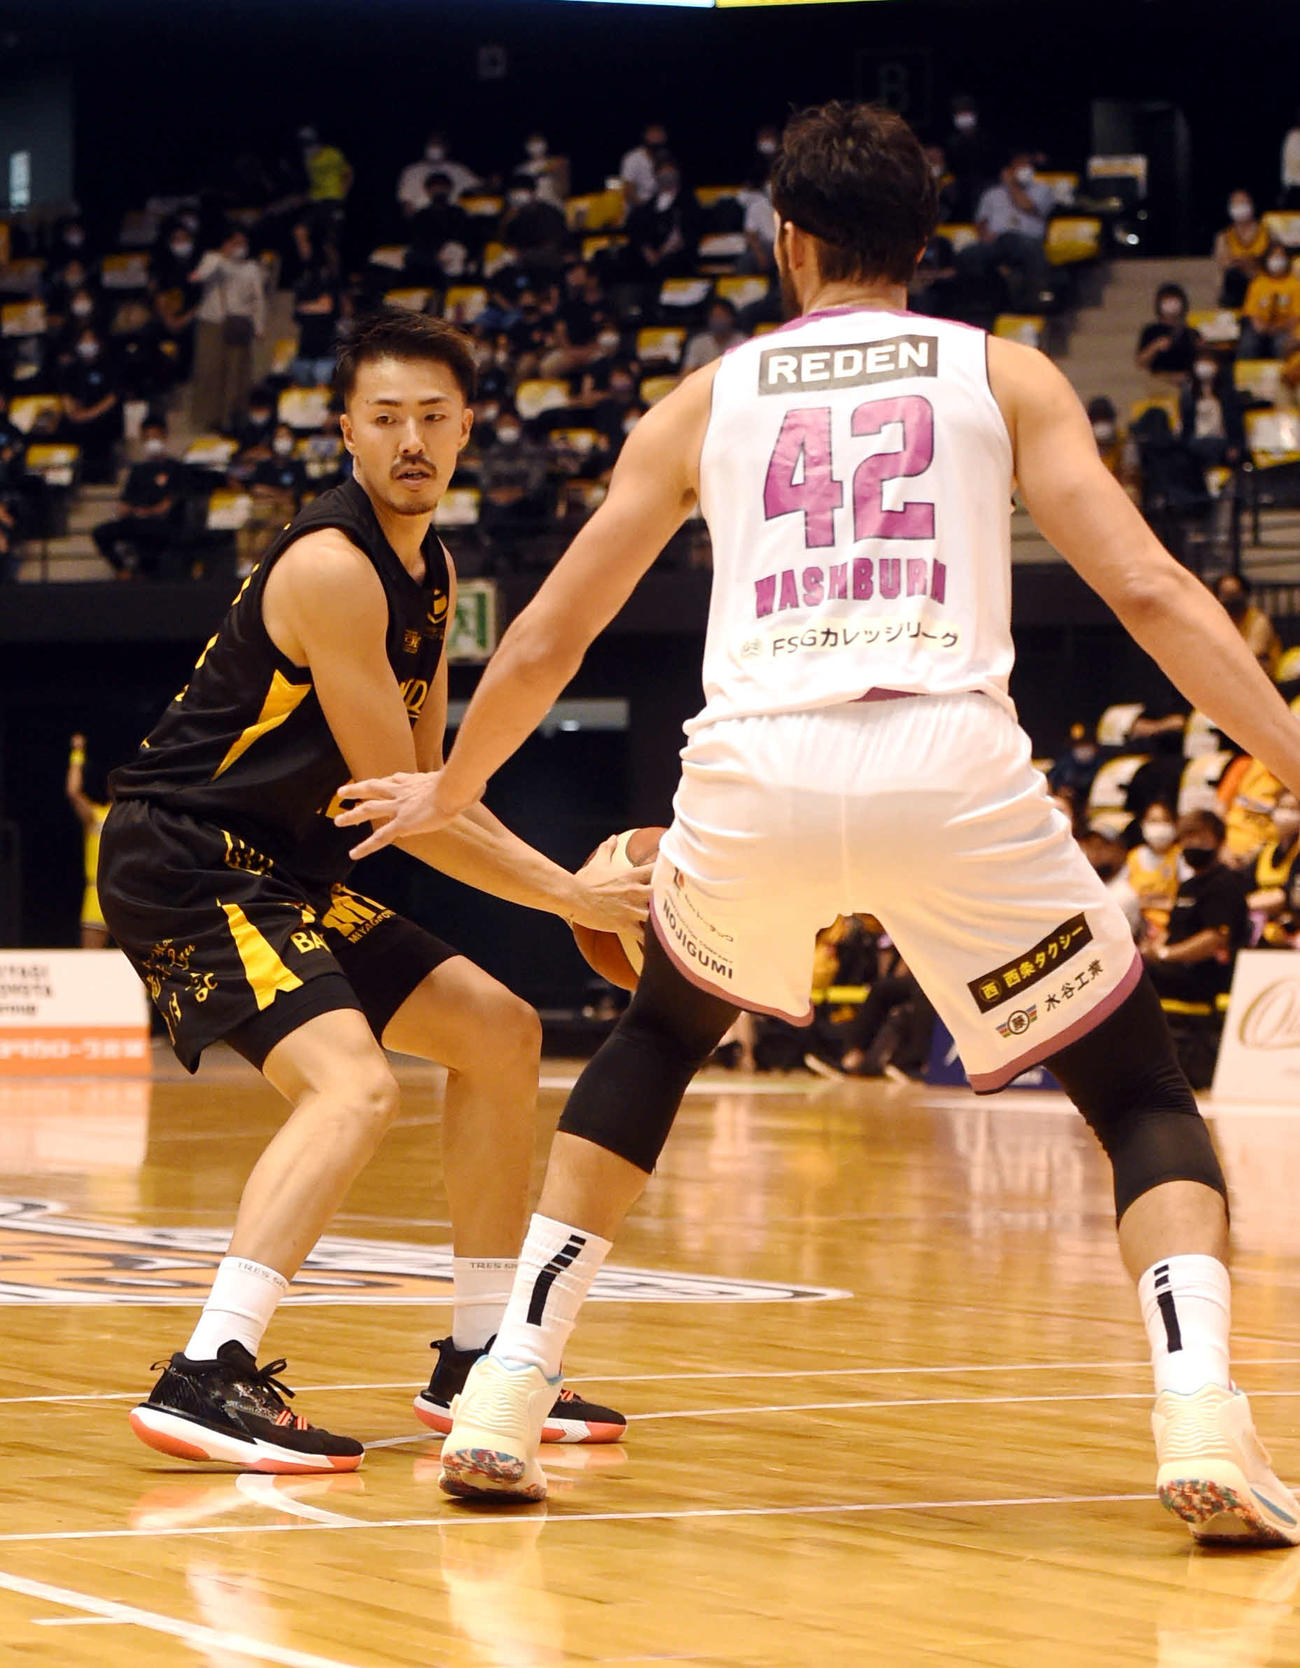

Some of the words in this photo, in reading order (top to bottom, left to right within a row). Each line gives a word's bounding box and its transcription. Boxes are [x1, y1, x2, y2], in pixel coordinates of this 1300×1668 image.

[768, 342, 929, 385] REDEN
[763, 395, 936, 549] 42
[663, 899, 733, 979] NOJIGUMI
[1002, 925, 1084, 988] 西条タクシー
[1044, 959, 1104, 1012] 水谷工業
